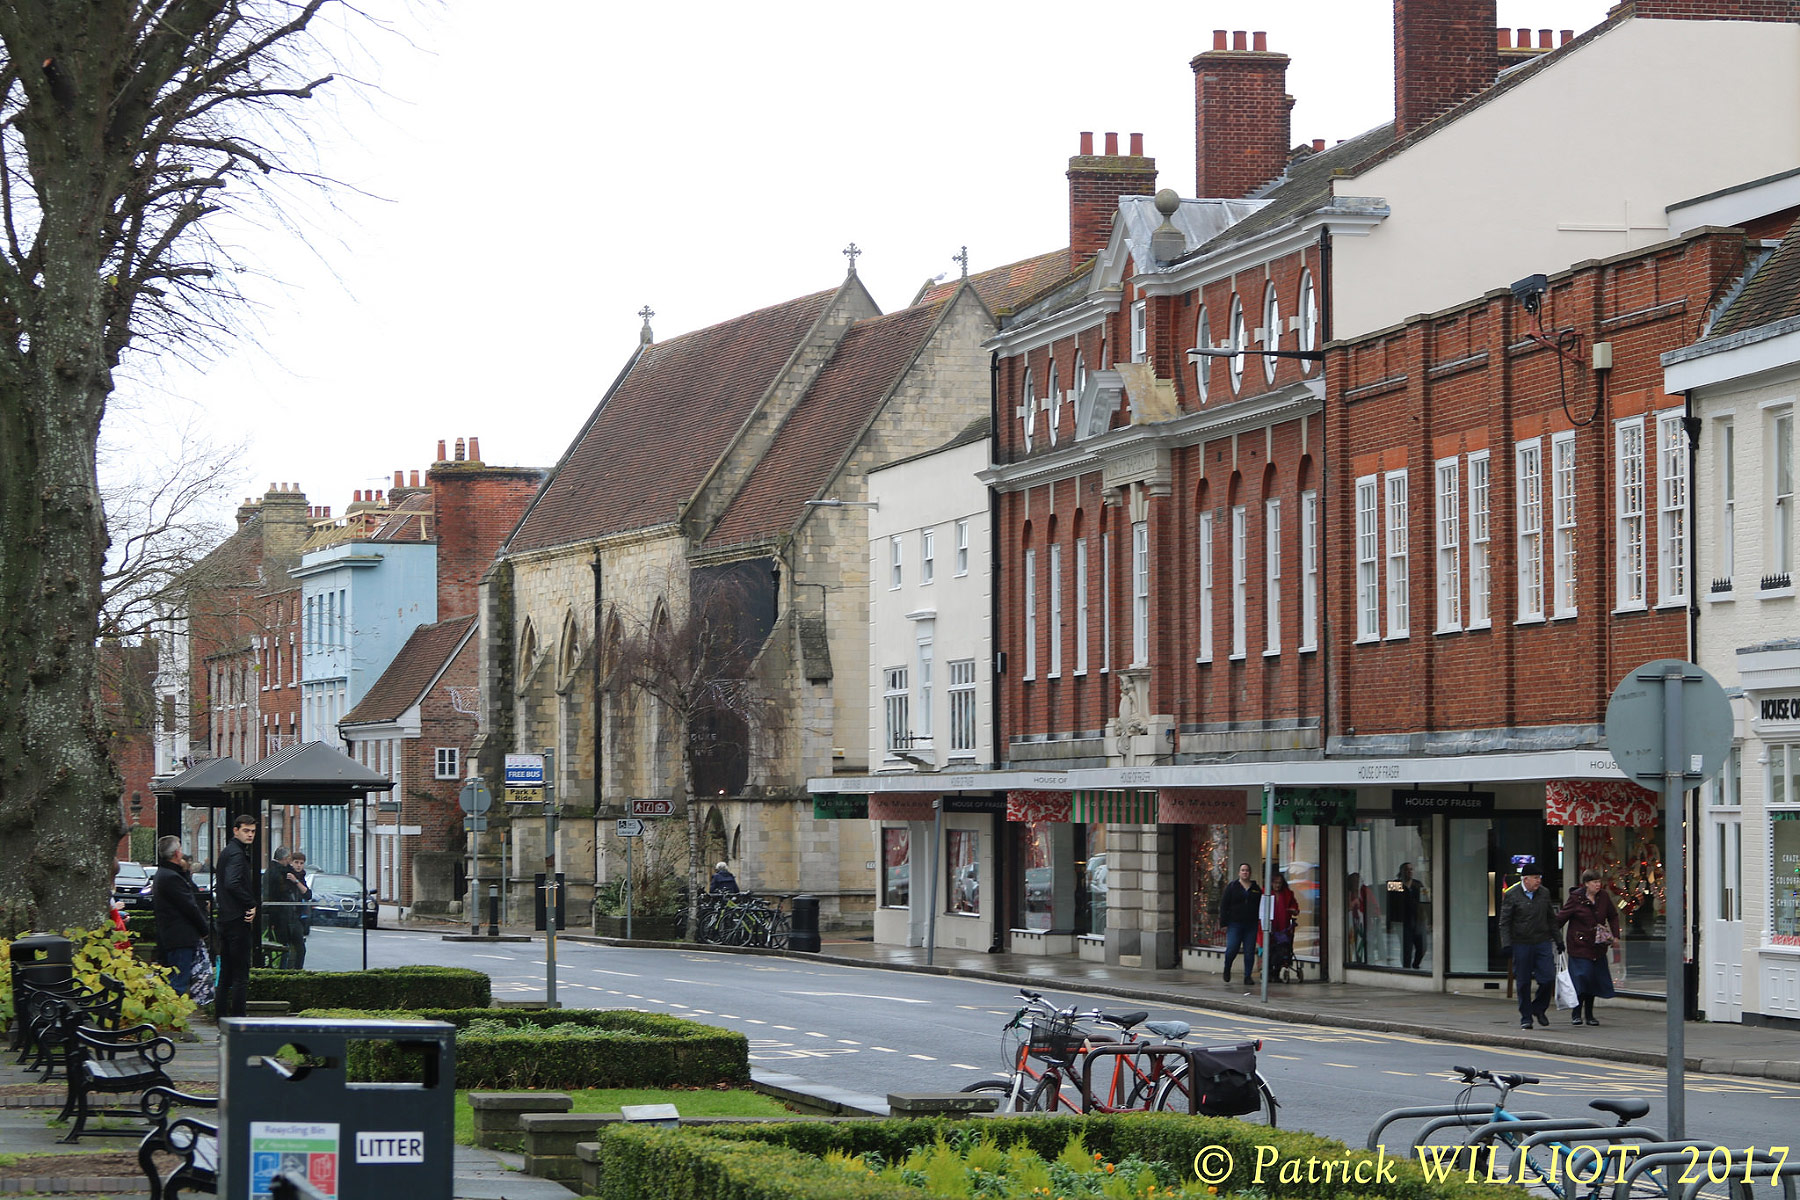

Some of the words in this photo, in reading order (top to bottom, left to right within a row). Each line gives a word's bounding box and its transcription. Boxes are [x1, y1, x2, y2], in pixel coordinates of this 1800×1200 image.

[1761, 698, 1790, 719] HOUSE
[508, 770, 525, 778] FREE
[525, 770, 541, 778] BUS
[1033, 776, 1056, 784] HOUSE
[1057, 776, 1068, 784] OF
[1405, 797, 1434, 806] HOUSE
[1436, 798, 1448, 807] OF
[1450, 798, 1482, 808] FRASER
[310, 1125, 326, 1135] Bin
[359, 1138, 422, 1157] LITTER
